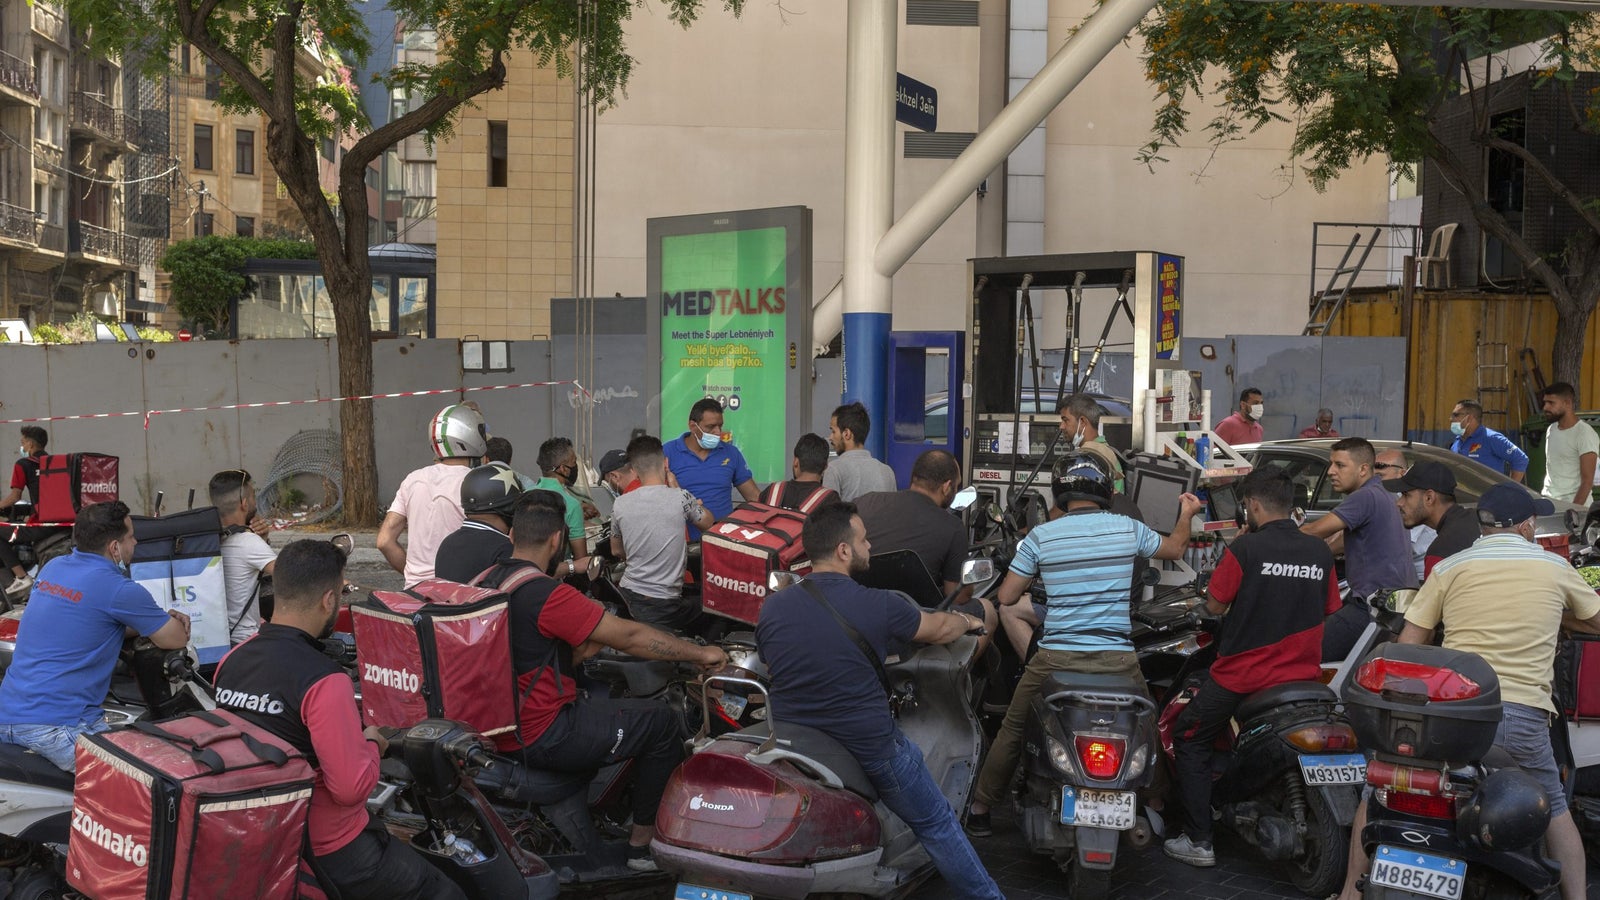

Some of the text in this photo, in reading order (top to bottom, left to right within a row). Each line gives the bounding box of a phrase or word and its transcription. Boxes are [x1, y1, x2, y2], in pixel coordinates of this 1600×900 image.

[672, 331, 691, 339] Meet
[692, 331, 704, 339] the
[705, 331, 728, 340] Super
[681, 357, 705, 367] mesh
[979, 471, 1001, 479] DIESEL
[81, 481, 117, 493] zomato
[1261, 562, 1324, 581] zomato
[706, 571, 766, 597] zomato
[364, 663, 419, 693] zomato
[215, 687, 285, 714] zomato
[701, 801, 735, 811] HONDA
[72, 807, 147, 867] zomato
[1375, 862, 1459, 896] M885479
